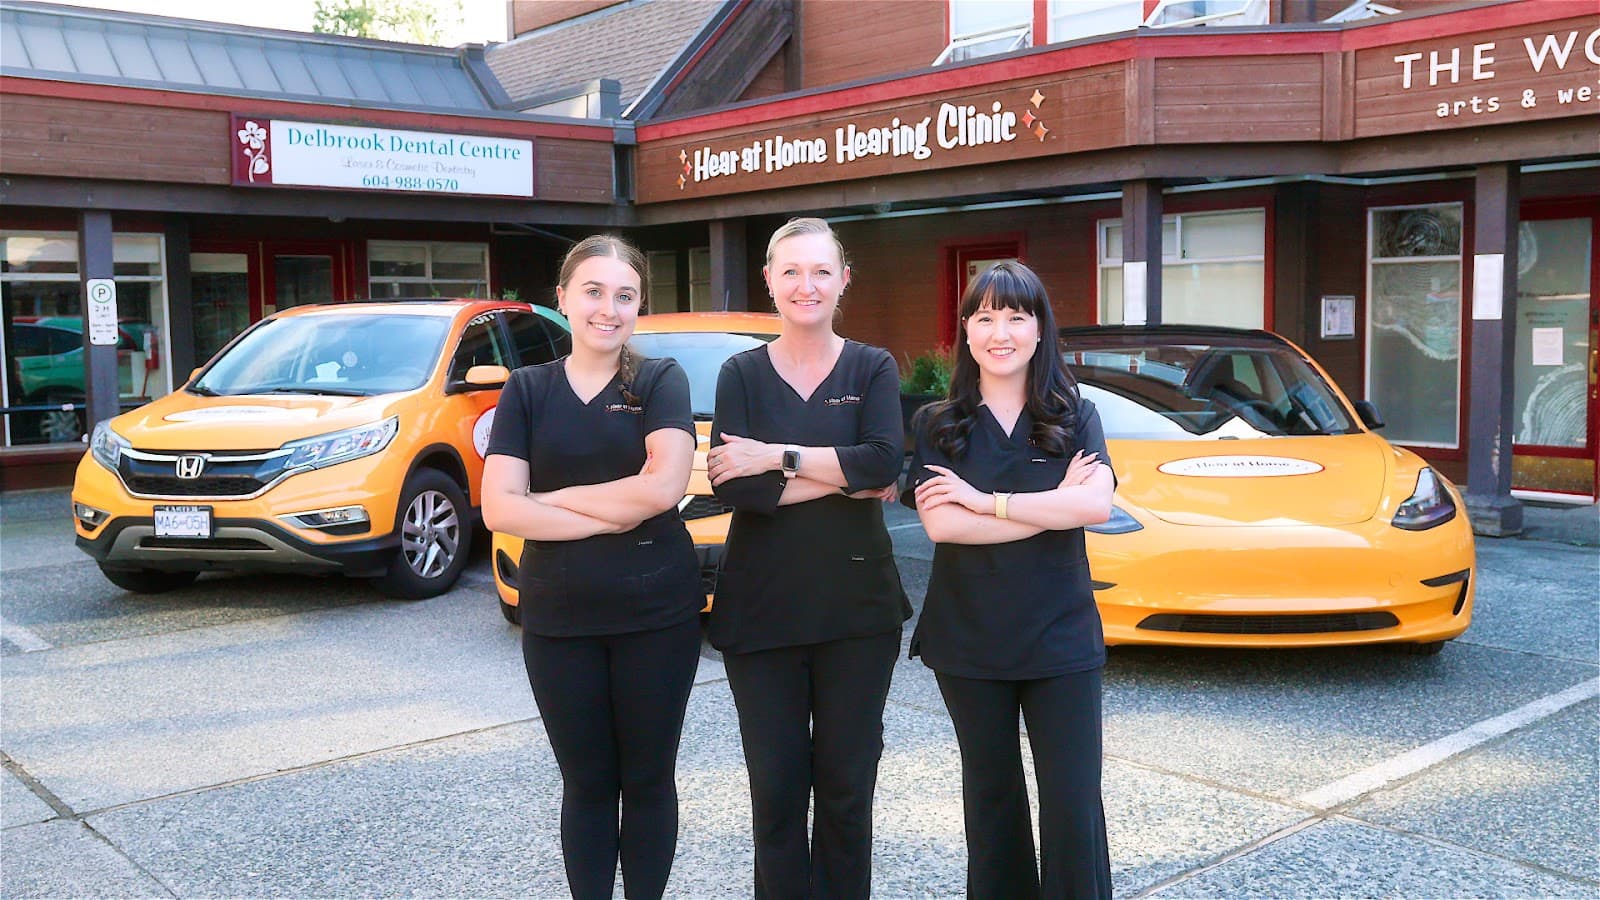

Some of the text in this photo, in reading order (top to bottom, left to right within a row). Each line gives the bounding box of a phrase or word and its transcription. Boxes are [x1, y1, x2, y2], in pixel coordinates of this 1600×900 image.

[1394, 42, 1496, 89] THE
[1436, 79, 1600, 118] arts & we
[287, 127, 521, 160] Delbrook Dental Centre
[693, 100, 1018, 183] Hear at Home Hearing Clinic
[362, 174, 459, 192] 604-988-0570
